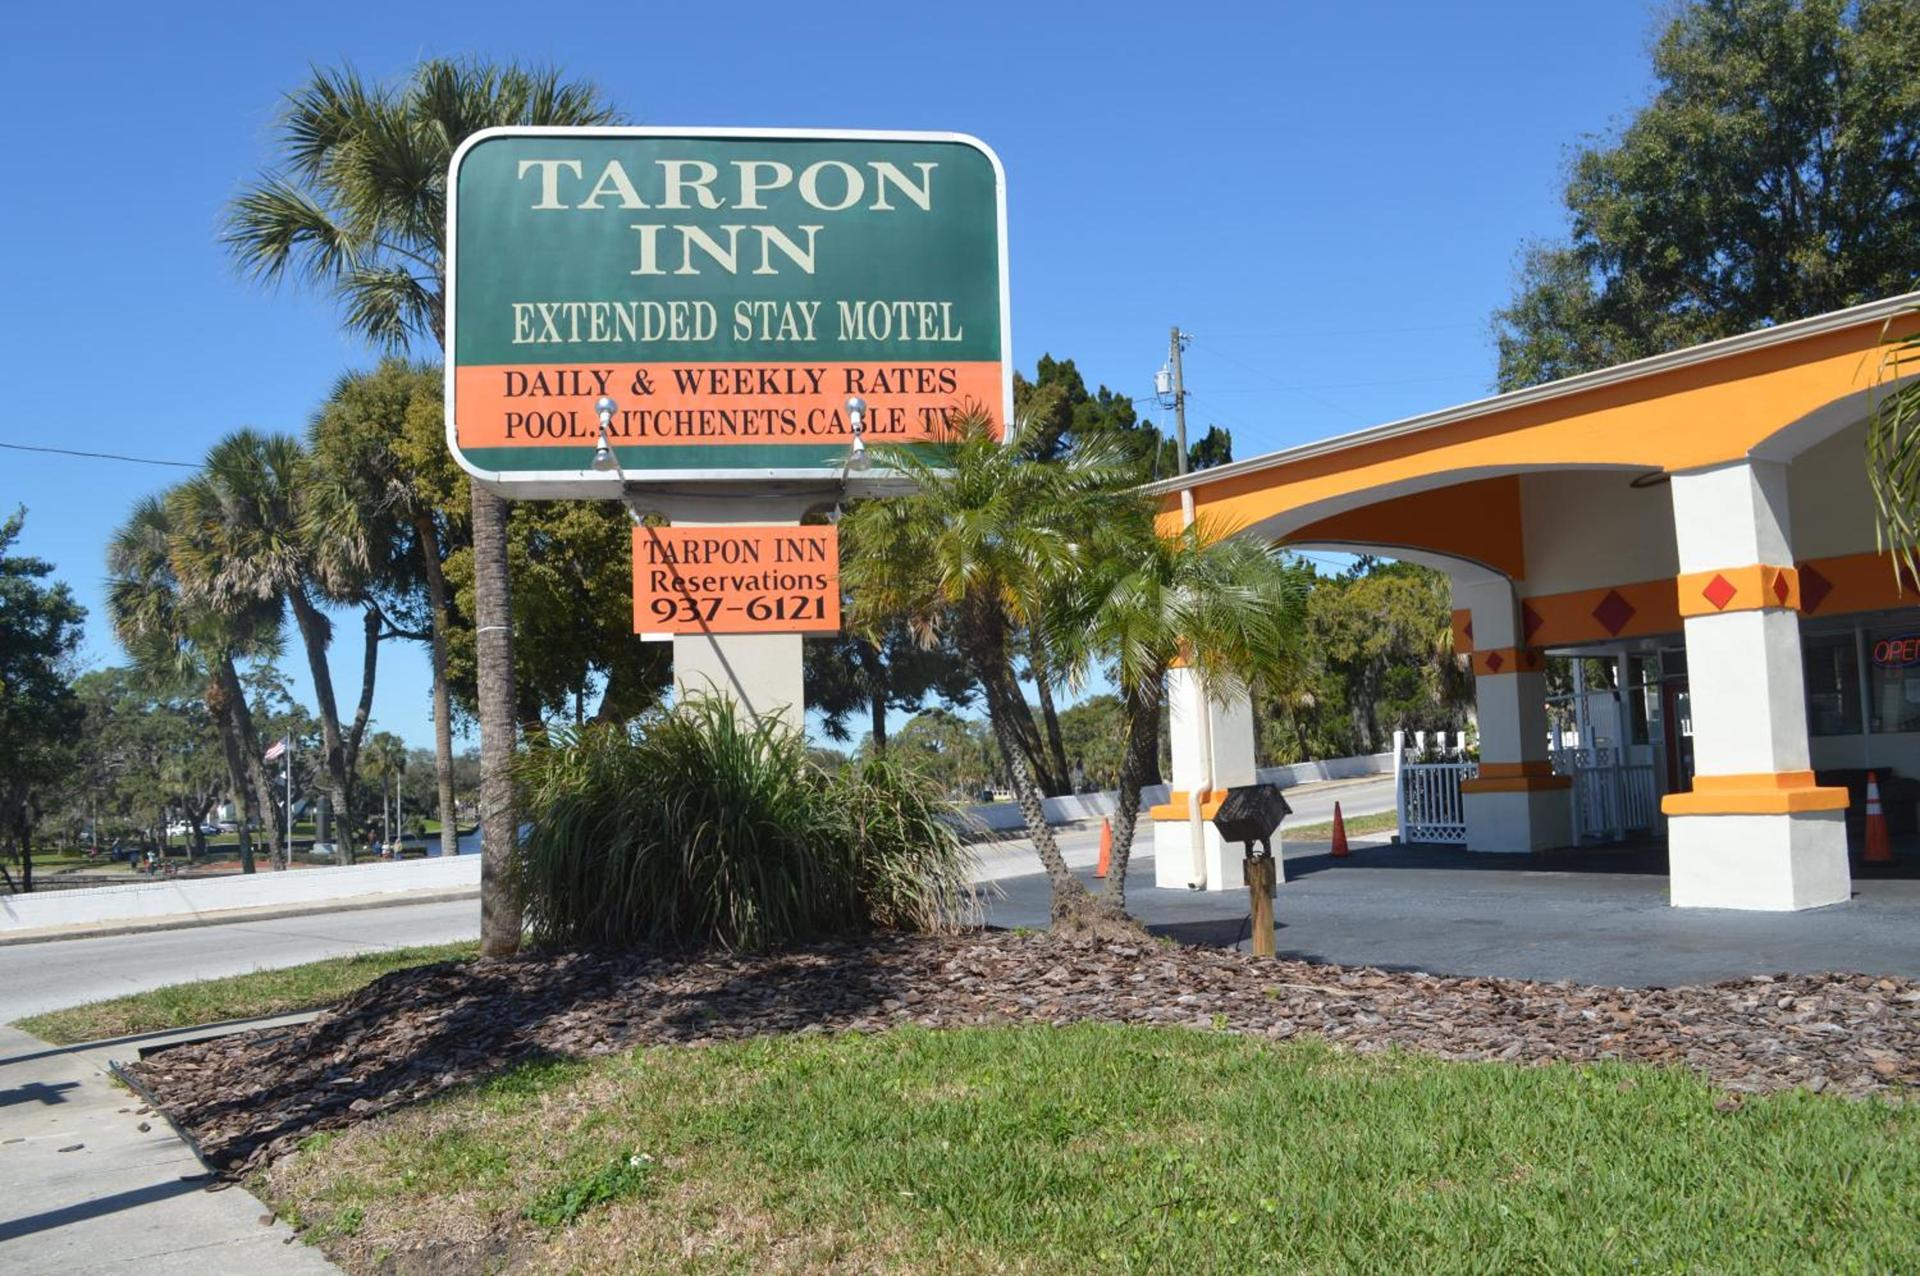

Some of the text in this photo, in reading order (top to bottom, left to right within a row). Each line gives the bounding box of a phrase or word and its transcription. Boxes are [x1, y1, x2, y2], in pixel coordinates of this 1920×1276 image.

[518, 160, 938, 211] TARPON
[630, 224, 824, 275] INN
[512, 300, 963, 344] EXTENDED STAY MOTEL
[504, 368, 957, 397] DAILY & WEEKLY RATES
[644, 538, 827, 564] TARPON INN
[651, 569, 827, 592] Reservations
[651, 595, 825, 623] 937-6121
